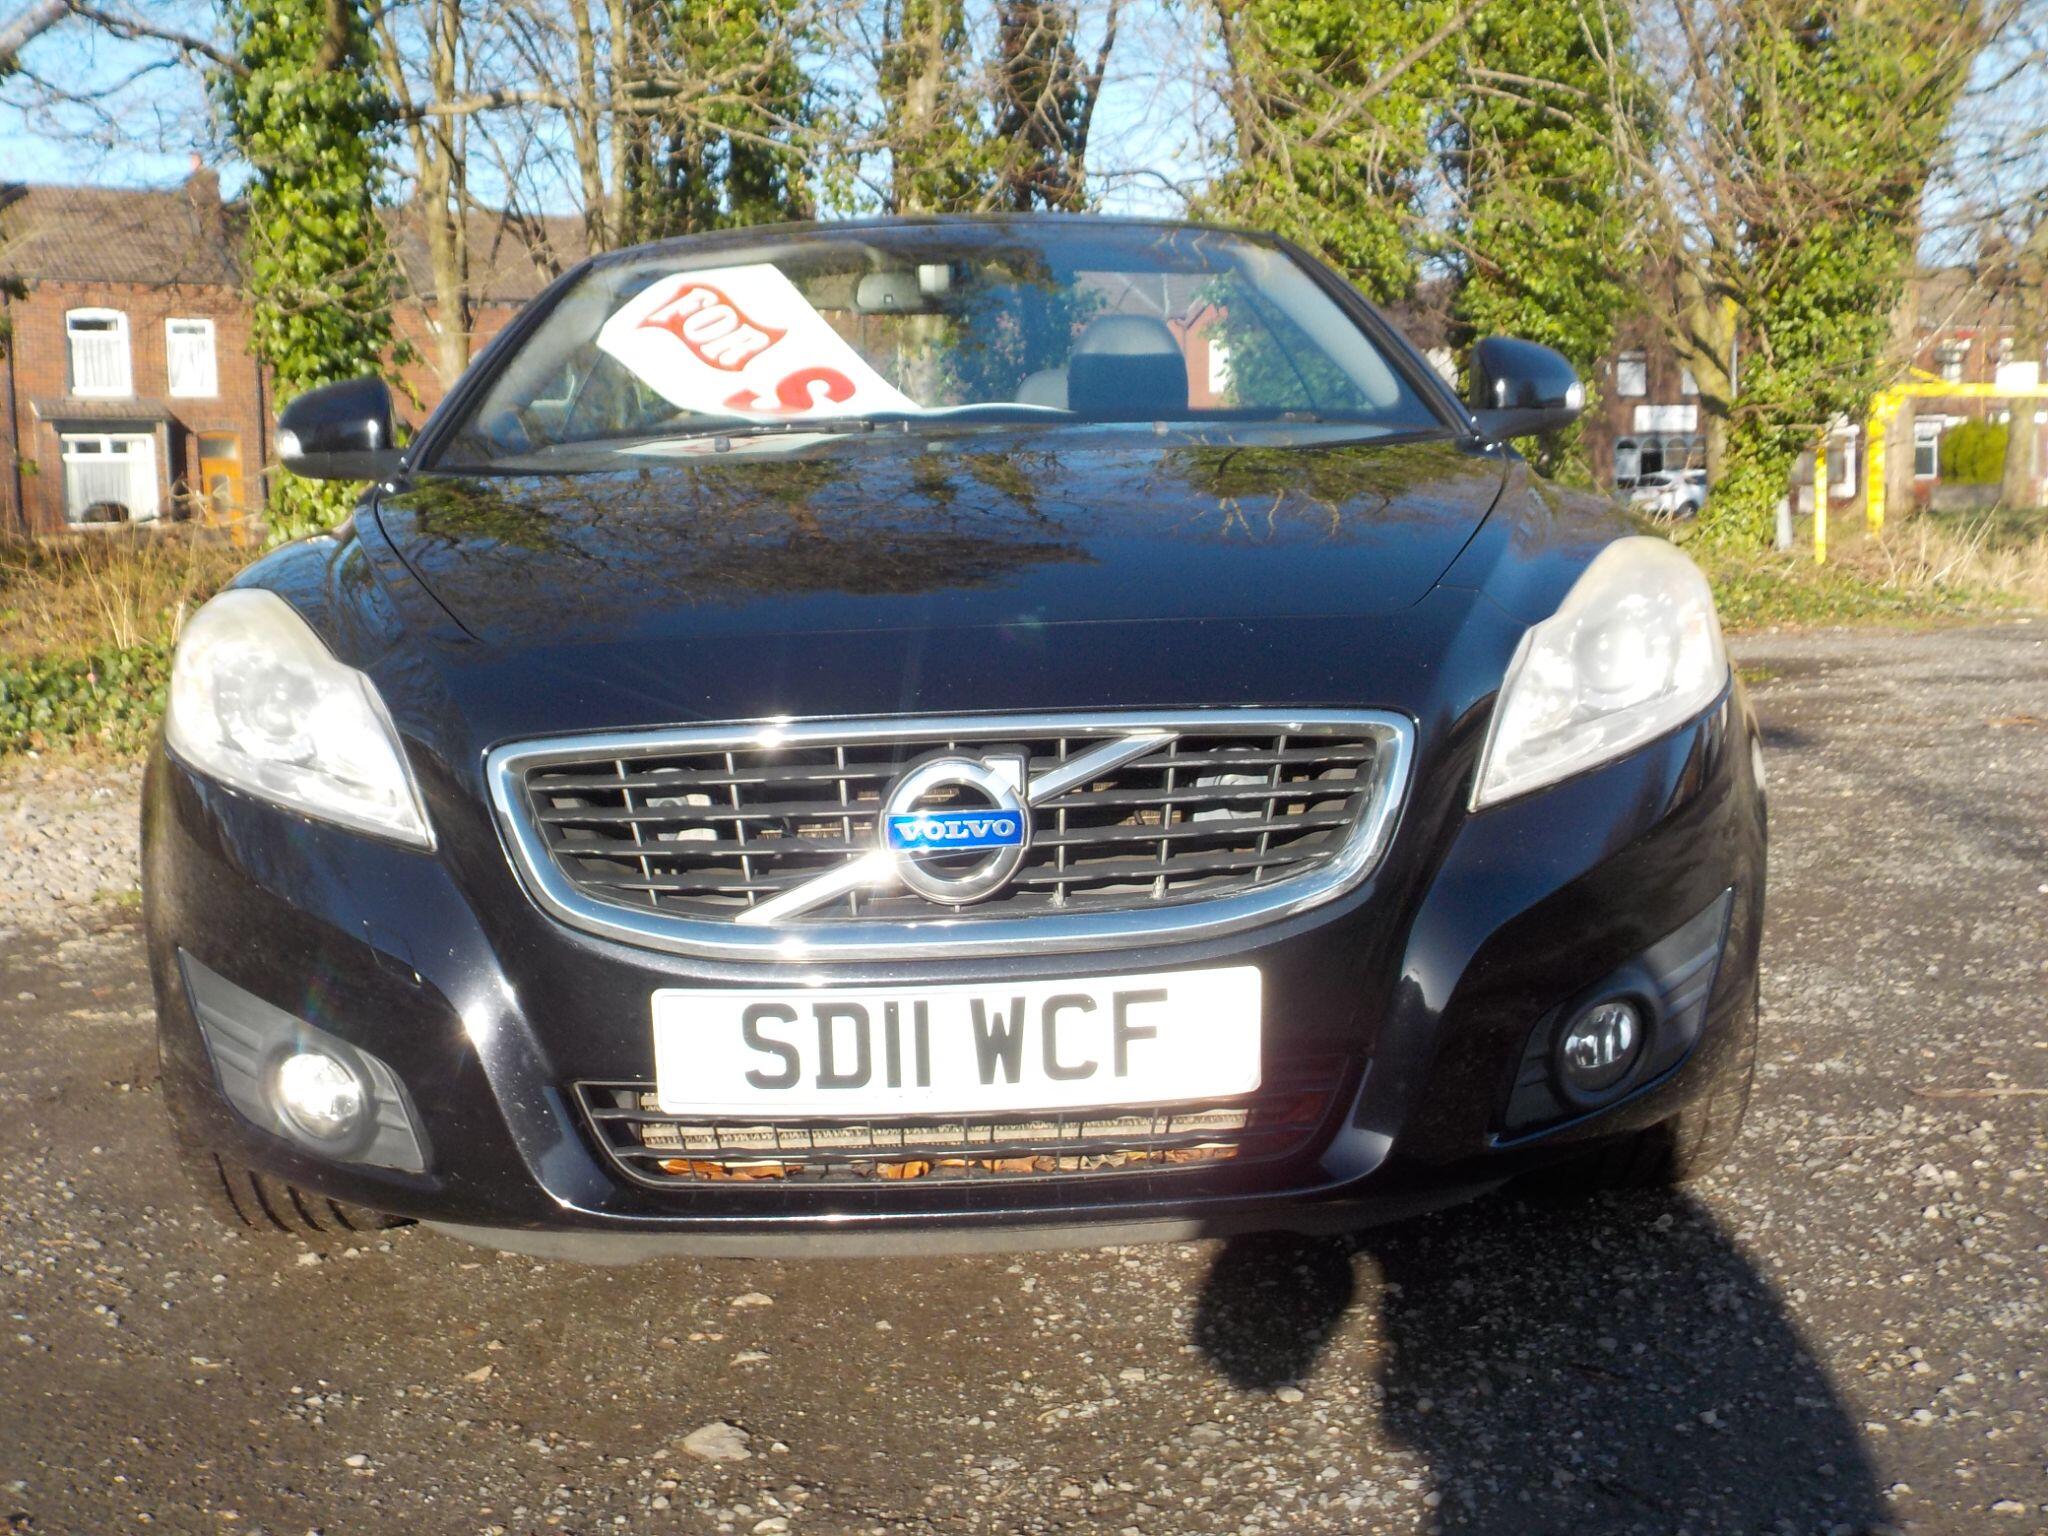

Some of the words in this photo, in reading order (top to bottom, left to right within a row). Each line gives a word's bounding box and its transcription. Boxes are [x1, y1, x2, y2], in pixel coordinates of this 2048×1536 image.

[644, 287, 772, 368] FOR
[893, 818, 1016, 842] VOLVO
[741, 999, 932, 1089] SD11
[970, 987, 1168, 1085] WCF
